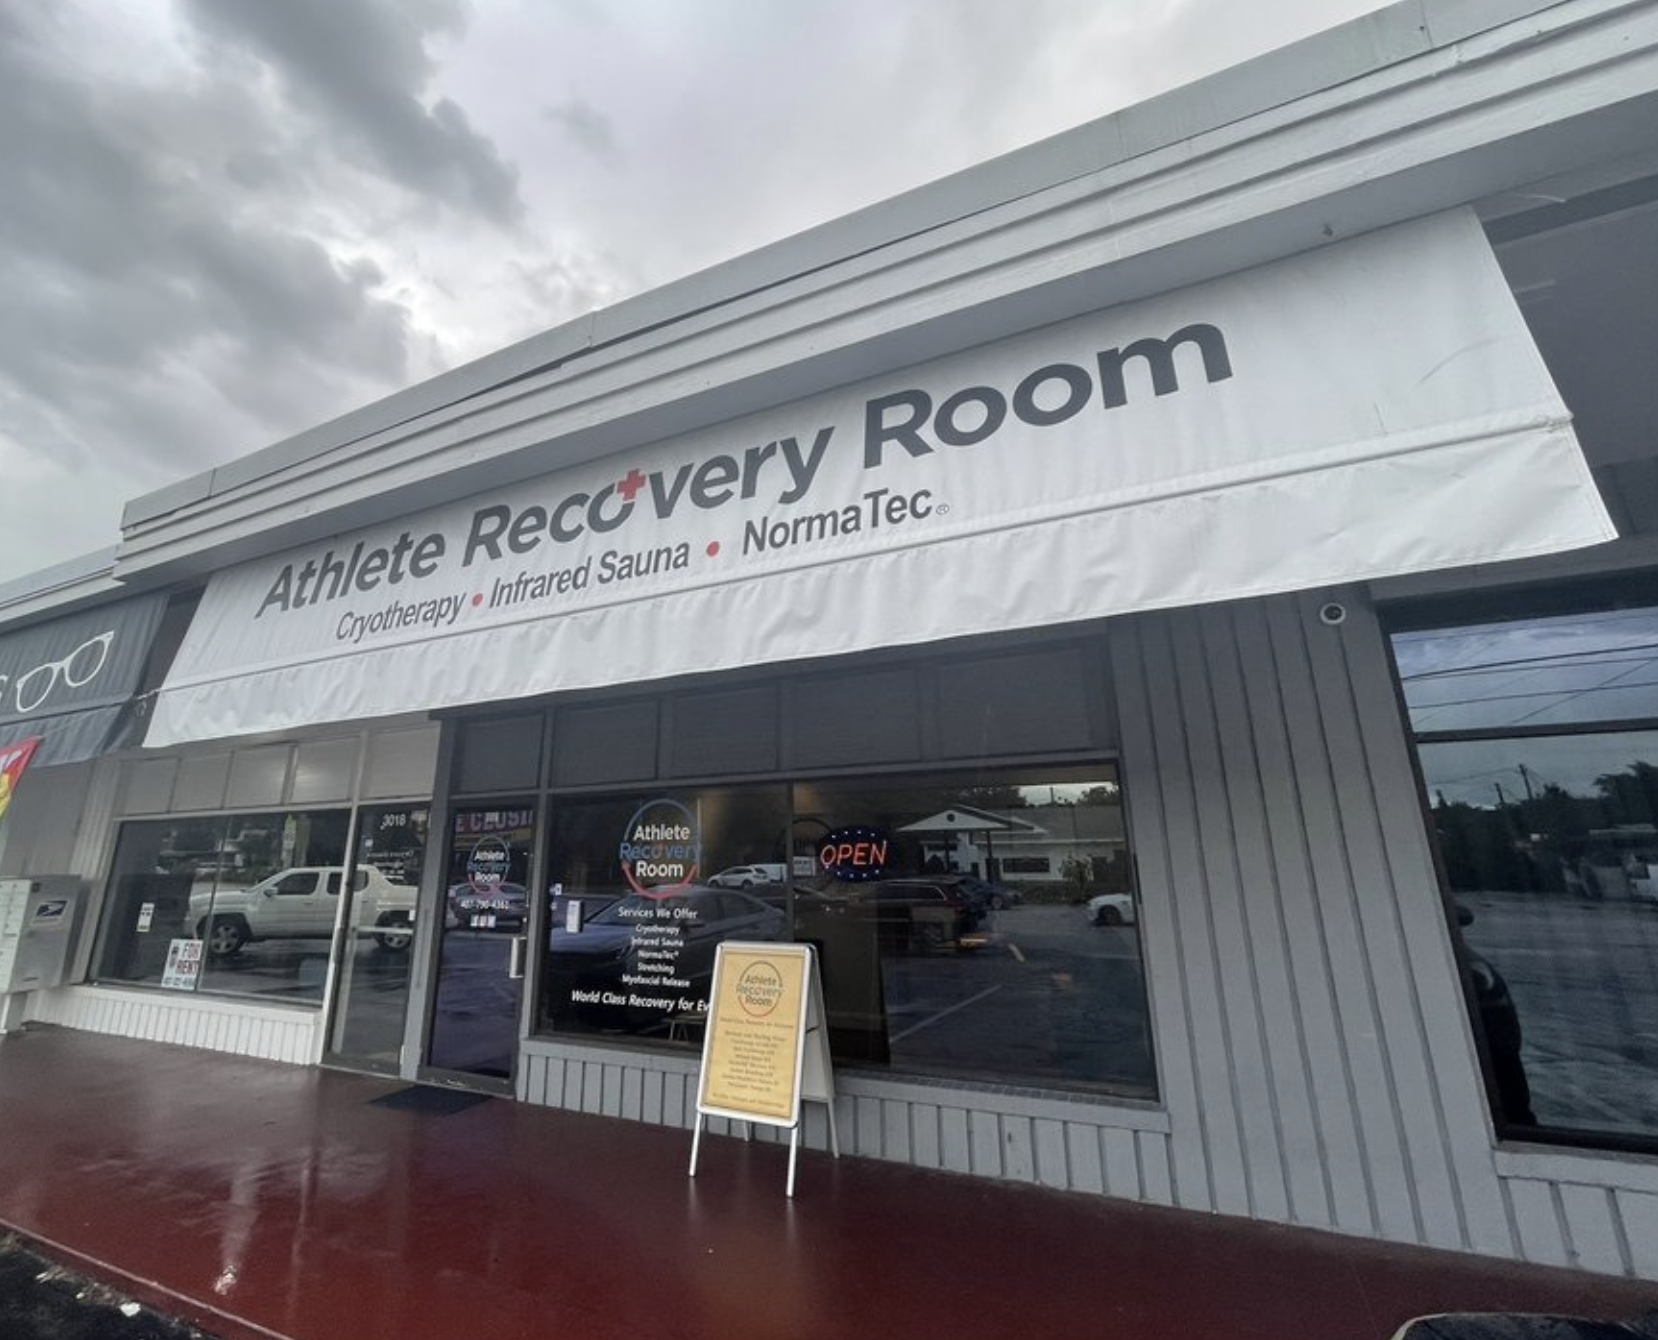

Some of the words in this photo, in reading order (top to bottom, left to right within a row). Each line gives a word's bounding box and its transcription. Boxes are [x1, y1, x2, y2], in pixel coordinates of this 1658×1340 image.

[254, 530, 446, 619] Athlete
[462, 425, 835, 568] Recovery
[864, 322, 1233, 470] Room
[335, 590, 467, 644] Cryotherapy
[489, 555, 593, 609] Infrared
[597, 541, 690, 586] Sauna
[633, 823, 691, 841] Athlete
[475, 850, 505, 861] Athlete
[619, 841, 704, 863] Recovery
[820, 840, 887, 867] OPEN
[635, 859, 684, 878] Room
[474, 872, 500, 883] Room
[618, 905, 654, 919] Services
[657, 907, 671, 919] We
[673, 908, 698, 920] Offer
[635, 923, 680, 936] Cryotherapy
[631, 936, 659, 947] Infrared
[661, 937, 684, 947] Sauna
[637, 962, 675, 975] Stretching
[622, 973, 660, 986] Myofascial
[662, 976, 691, 988] Release
[745, 974, 777, 987] Athlete
[735, 982, 784, 997] Recovery
[572, 989, 600, 1003] World
[602, 991, 626, 1006] Class
[628, 994, 675, 1013] Recovery
[677, 997, 695, 1011] for
[745, 994, 773, 1006] Room
